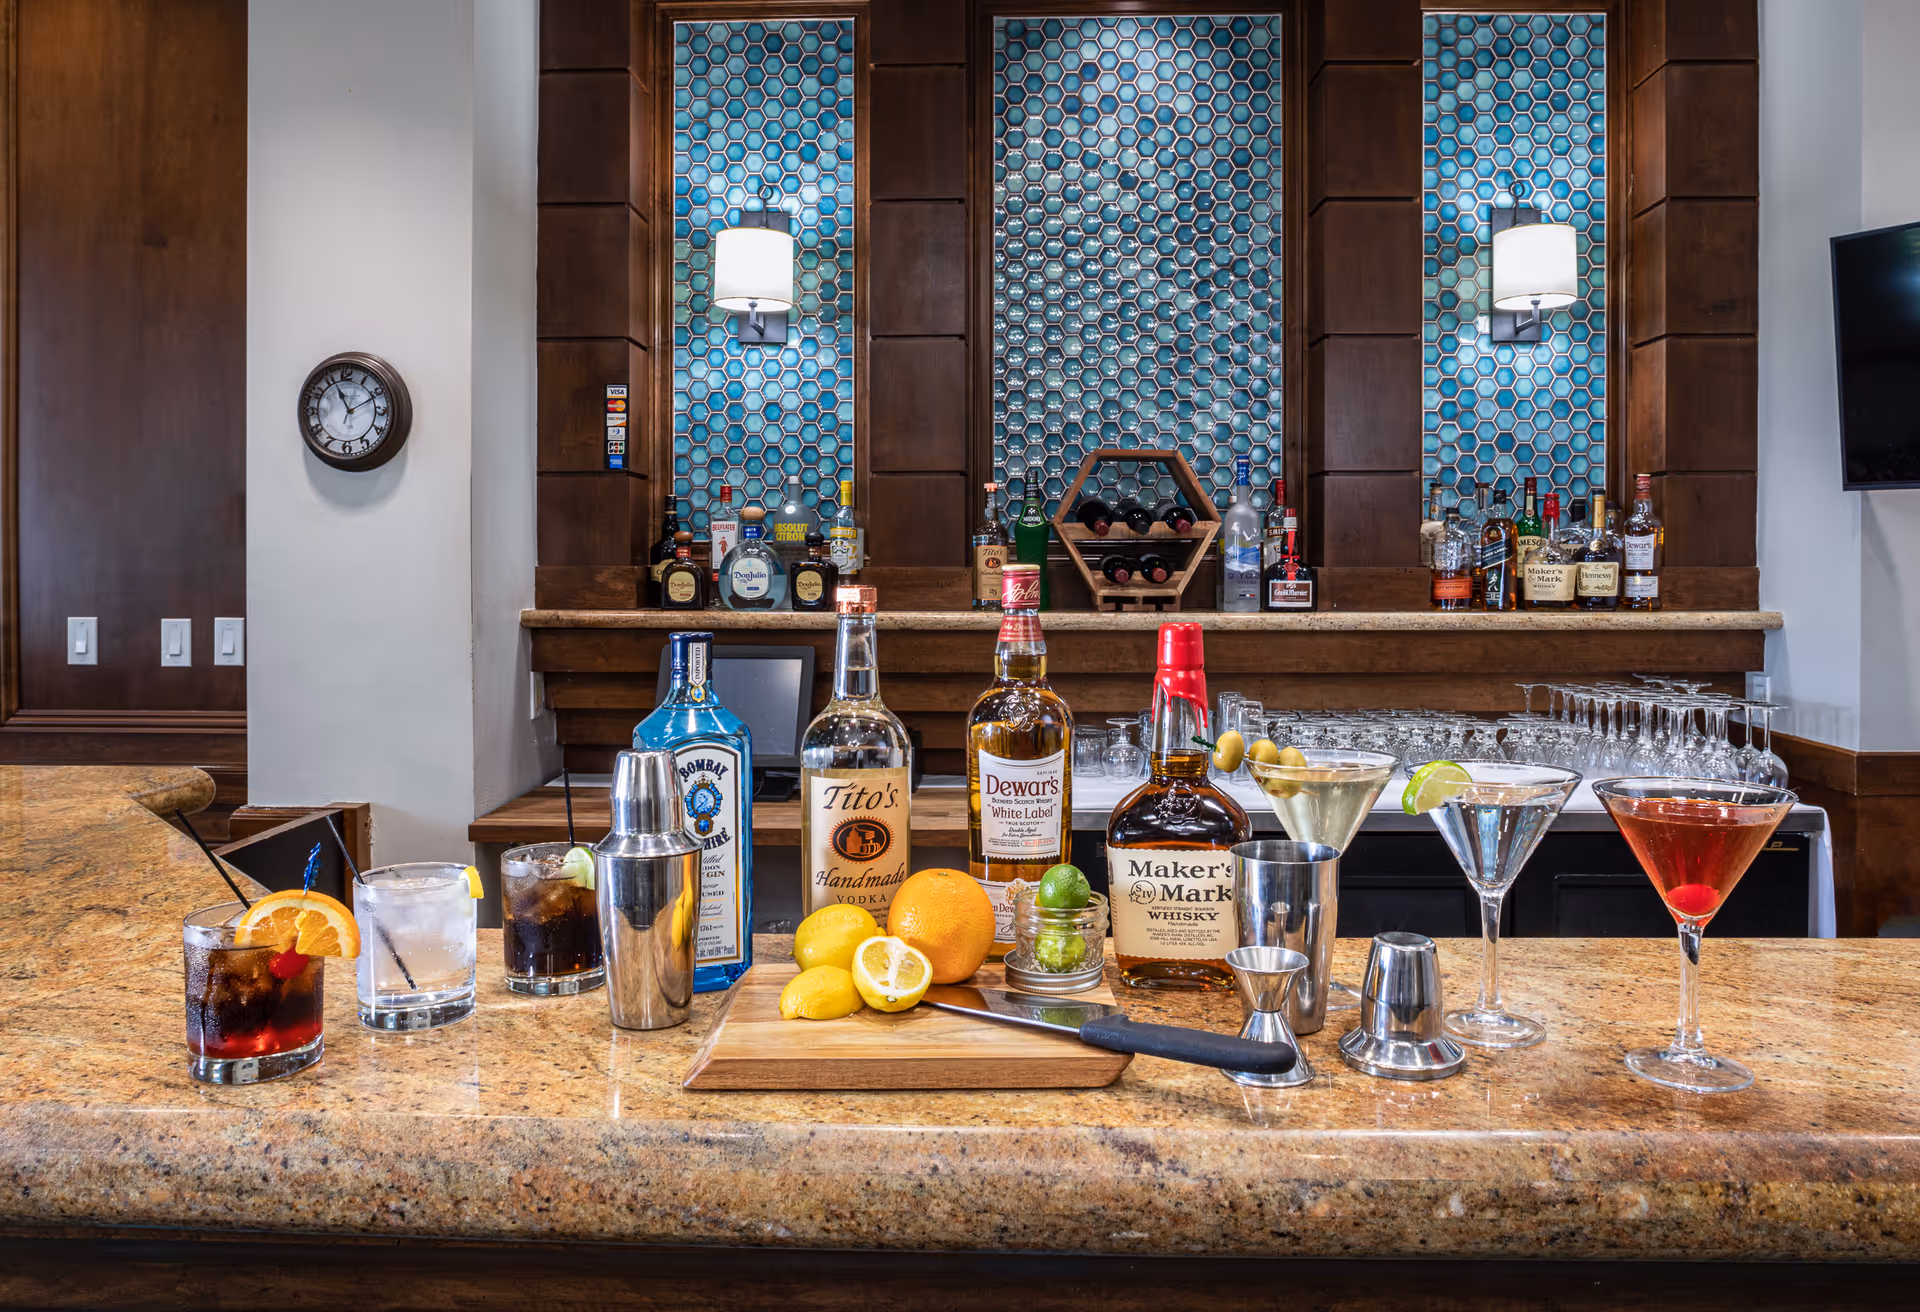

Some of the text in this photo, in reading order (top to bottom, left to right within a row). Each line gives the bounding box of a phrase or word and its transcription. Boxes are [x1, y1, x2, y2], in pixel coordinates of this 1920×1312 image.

[340, 367, 353, 381] 12
[361, 375, 368, 385] 1
[370, 386, 384, 399] 2
[376, 405, 388, 417] 3
[374, 424, 384, 435] 4
[342, 440, 352, 454] 6
[360, 438, 370, 450] 5
[712, 524, 736, 532] BEEFEATER
[774, 523, 808, 532] ABSOLUT
[776, 532, 805, 542] CITRON
[679, 758, 728, 782] BOMBAY
[986, 774, 1059, 797] Dewar's
[822, 782, 898, 810] Tito's
[703, 827, 731, 850] HIRE
[706, 870, 725, 878] GIN
[816, 862, 905, 888] Handmade
[1128, 860, 1232, 878] Maker's
[1136, 884, 1153, 898] S IV
[1160, 884, 1232, 902] Mark
[836, 894, 886, 904] VODKA
[1147, 911, 1220, 921] WHISKY
